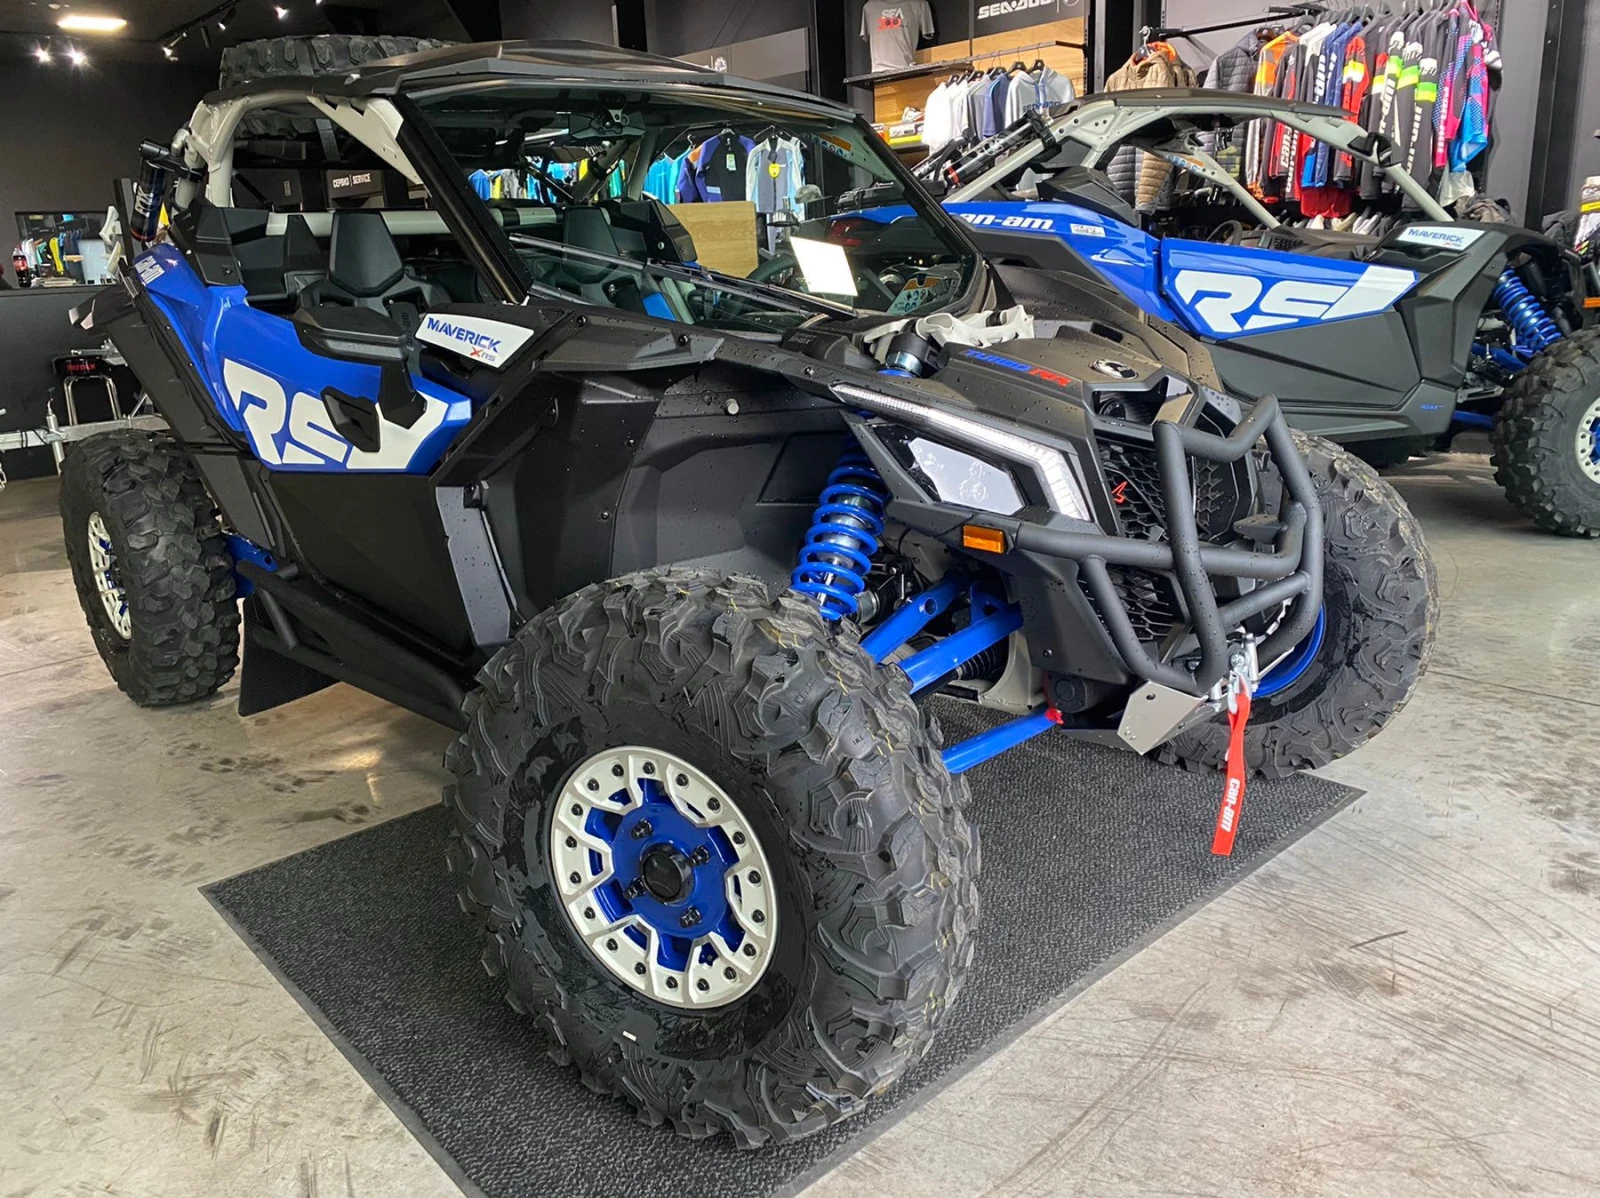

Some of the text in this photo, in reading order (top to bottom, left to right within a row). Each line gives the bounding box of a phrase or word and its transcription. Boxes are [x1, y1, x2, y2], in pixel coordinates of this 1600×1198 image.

[958, 212, 1054, 230] an-am
[1408, 228, 1464, 243] MAVERICK
[427, 317, 502, 353] MAVERICK
[1219, 777, 1241, 833] can-am
